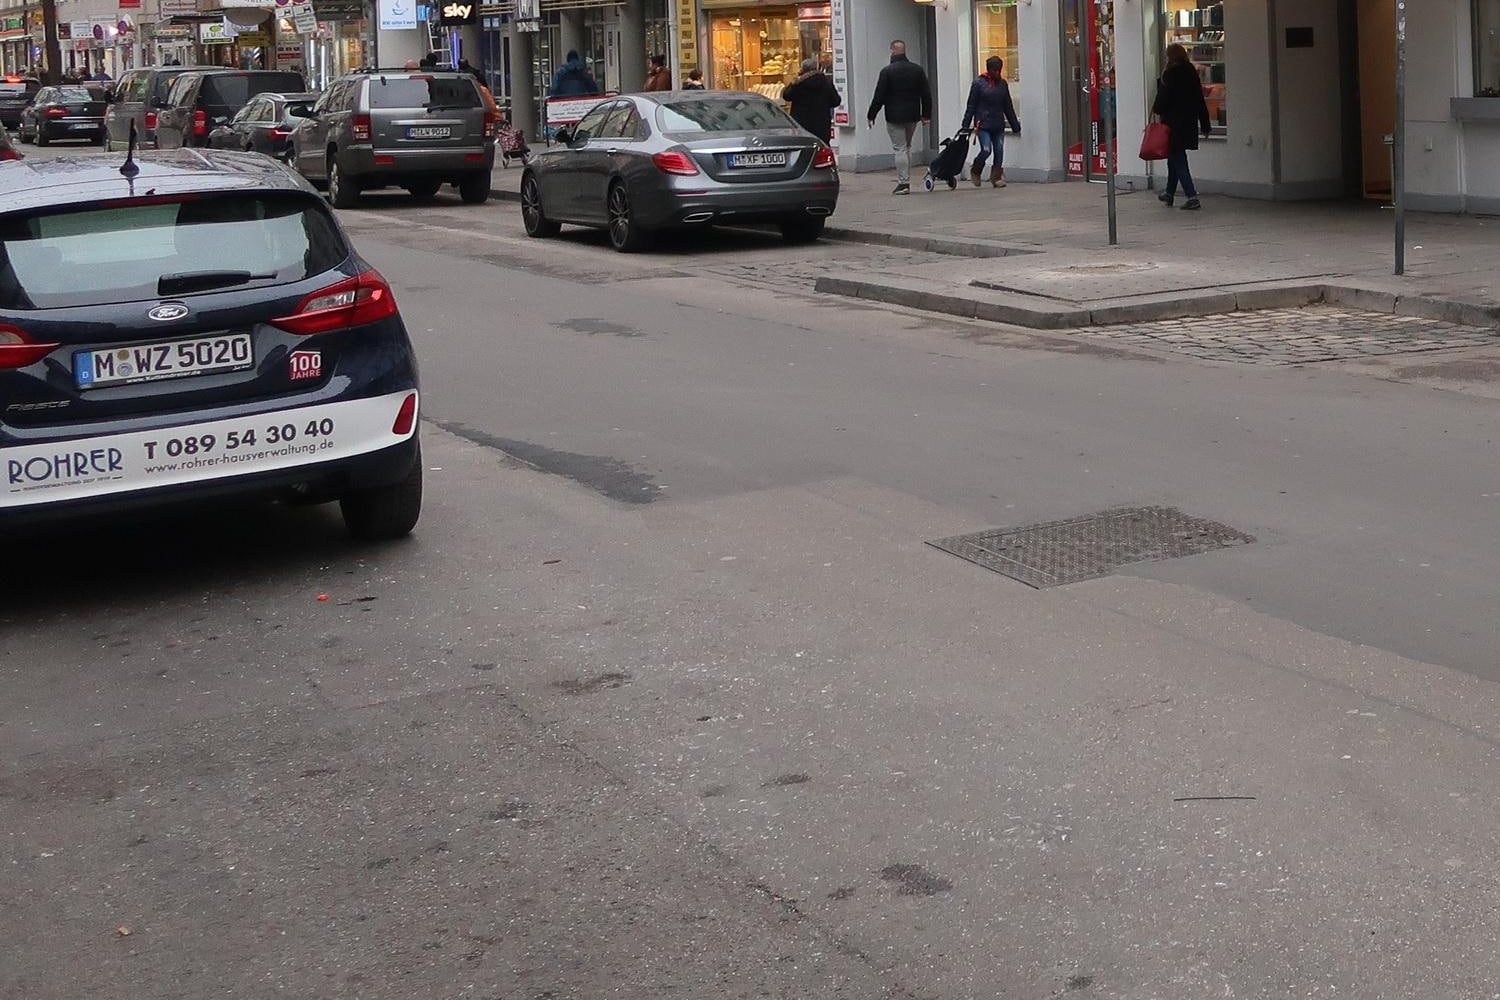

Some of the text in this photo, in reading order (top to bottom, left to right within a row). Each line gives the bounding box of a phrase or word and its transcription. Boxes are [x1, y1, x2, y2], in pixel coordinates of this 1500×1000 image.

[443, 2, 472, 20] sky
[748, 154, 759, 164] XF
[761, 153, 784, 164] 1000
[156, 306, 180, 318] Ford
[96, 337, 248, 378] M WZ 5020
[290, 354, 321, 373] 100
[291, 368, 321, 380] JAHRE
[144, 418, 335, 459] T 089 54 30 40
[8, 447, 123, 485] ROHRER
[144, 441, 334, 474] www.rohrer-hausverwaltung.de
